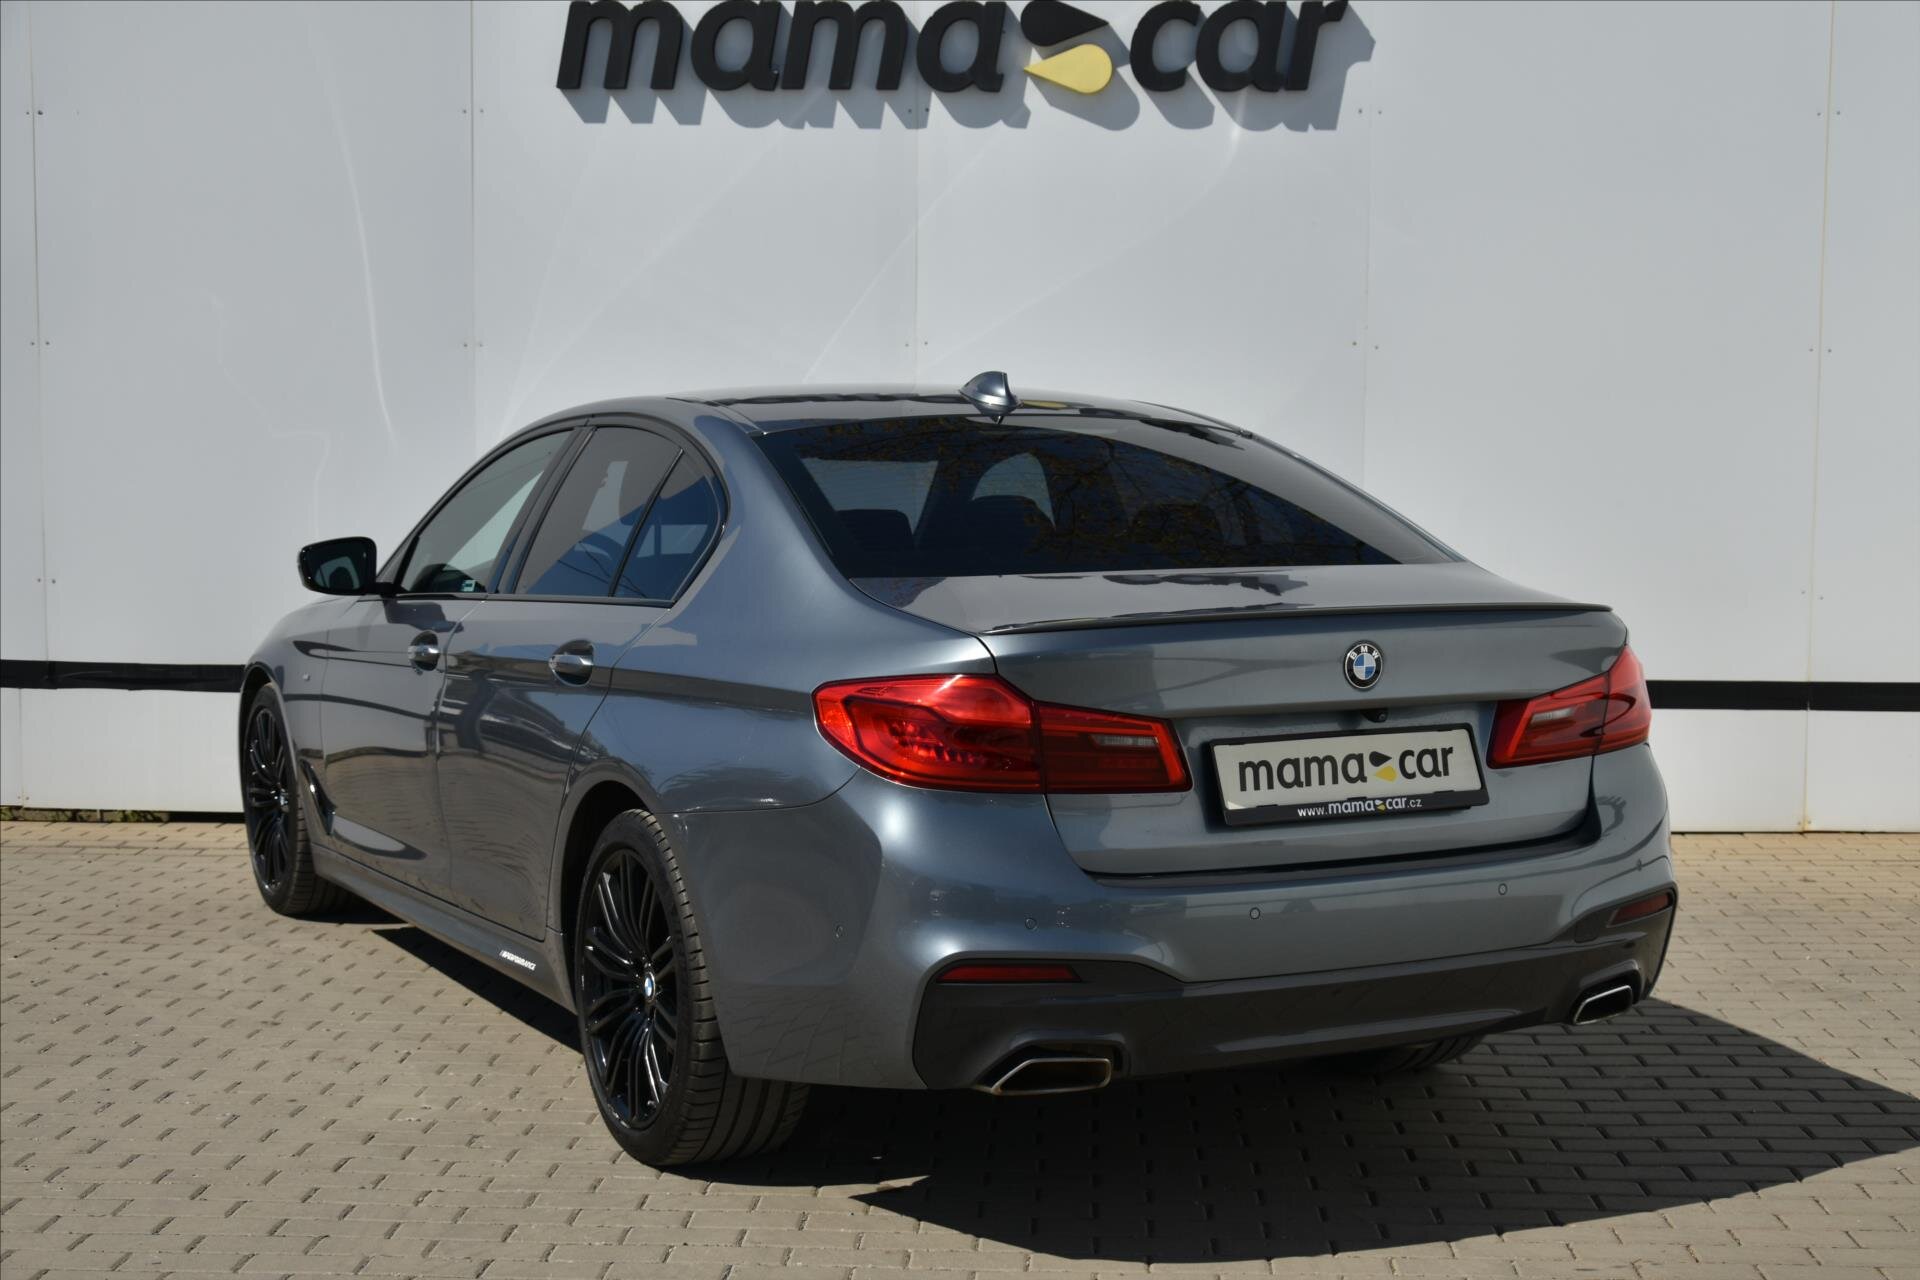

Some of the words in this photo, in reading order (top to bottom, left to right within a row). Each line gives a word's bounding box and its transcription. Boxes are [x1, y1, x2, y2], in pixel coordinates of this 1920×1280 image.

[556, 0, 1005, 93] mama
[1129, 0, 1348, 93] car
[1349, 645, 1380, 660] BMW
[1238, 752, 1368, 792] mama
[1398, 746, 1454, 780] car
